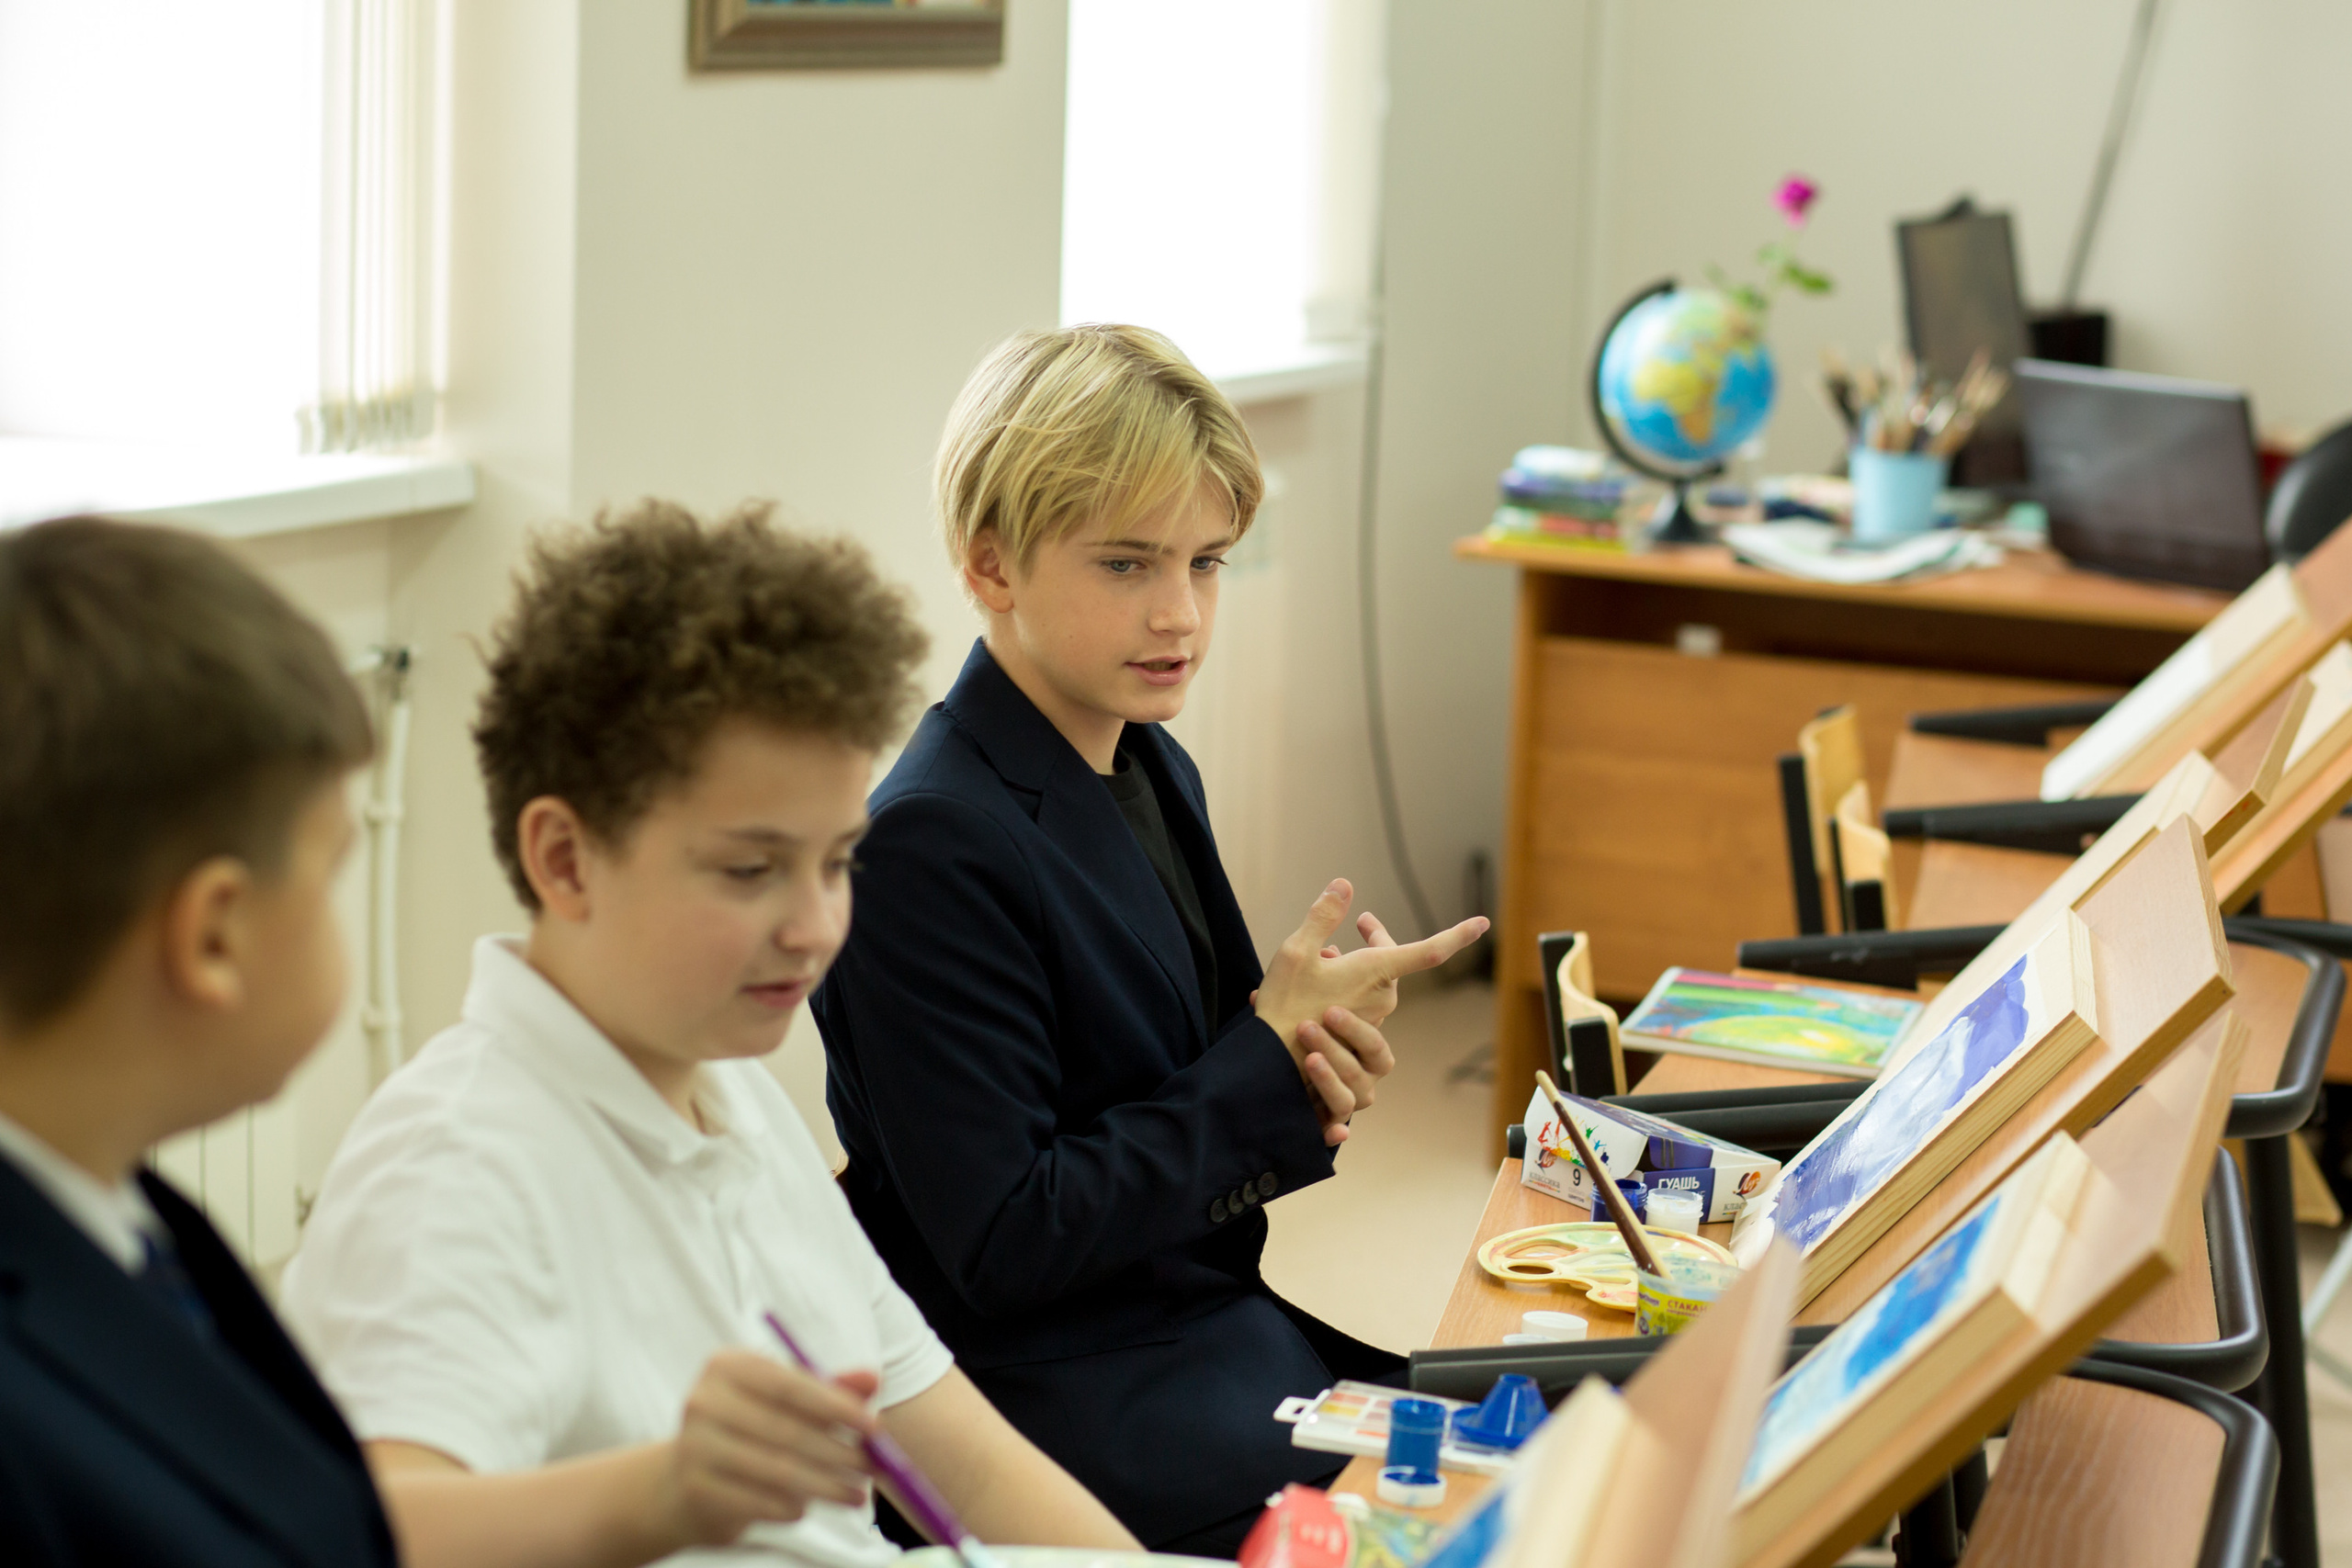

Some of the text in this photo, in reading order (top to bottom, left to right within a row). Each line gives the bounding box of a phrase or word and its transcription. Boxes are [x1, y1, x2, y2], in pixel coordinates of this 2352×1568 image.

[1572, 1168, 1581, 1187] 9
[1657, 1176, 1701, 1191] ГУАШЬ
[1668, 1300, 1709, 1314] СТАКАН
